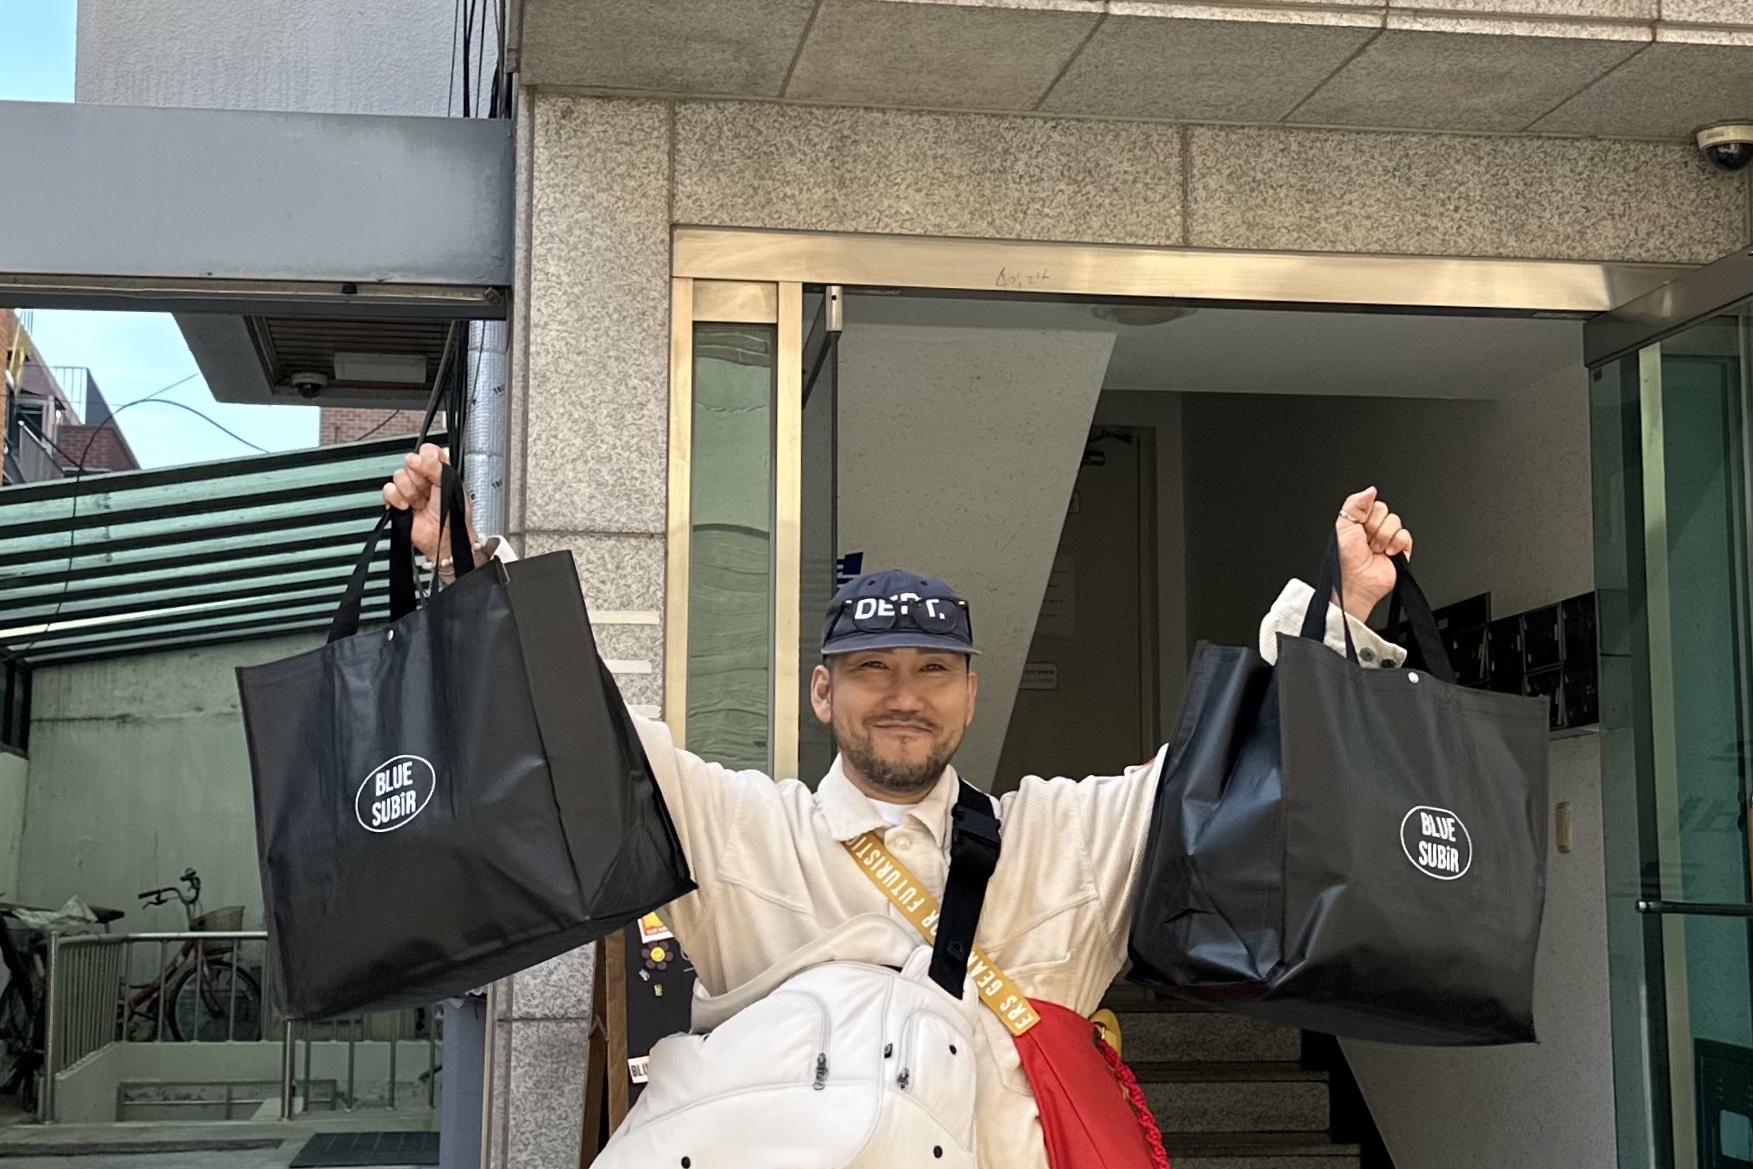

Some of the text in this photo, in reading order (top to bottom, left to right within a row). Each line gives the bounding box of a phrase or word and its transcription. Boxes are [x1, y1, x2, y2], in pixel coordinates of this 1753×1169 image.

[854, 593, 946, 620] DEPT.
[375, 761, 413, 796] BLUE
[1420, 811, 1456, 842] BLUE
